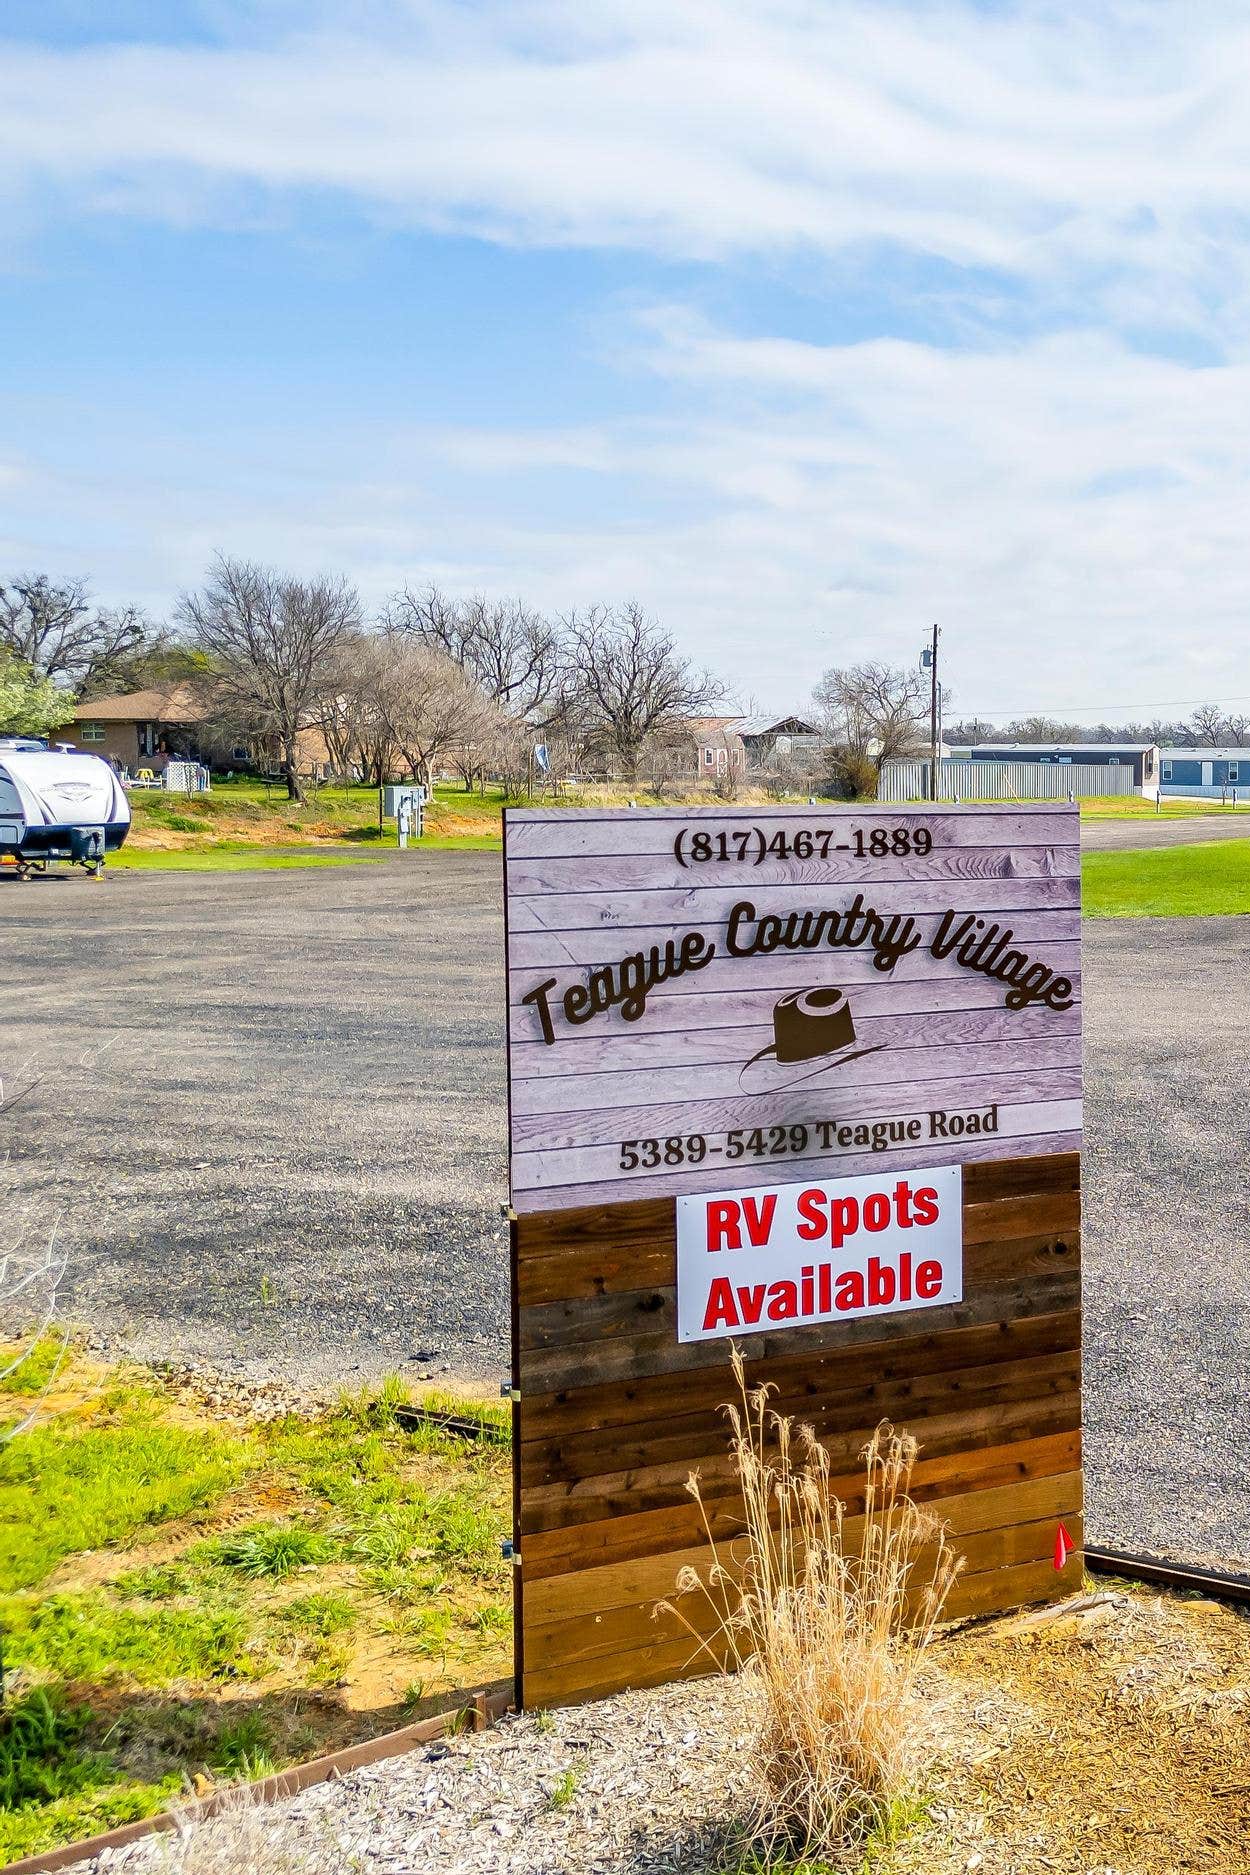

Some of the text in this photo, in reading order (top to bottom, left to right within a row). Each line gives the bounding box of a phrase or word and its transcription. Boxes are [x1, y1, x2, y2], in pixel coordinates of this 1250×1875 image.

[673, 827, 933, 867] (817)467-1889
[522, 893, 1075, 1046] Teague Country Village
[619, 1105, 999, 1171] 5389-5429 Teague Road
[706, 1181, 939, 1252] RV Spots
[702, 1253, 943, 1331] Available
